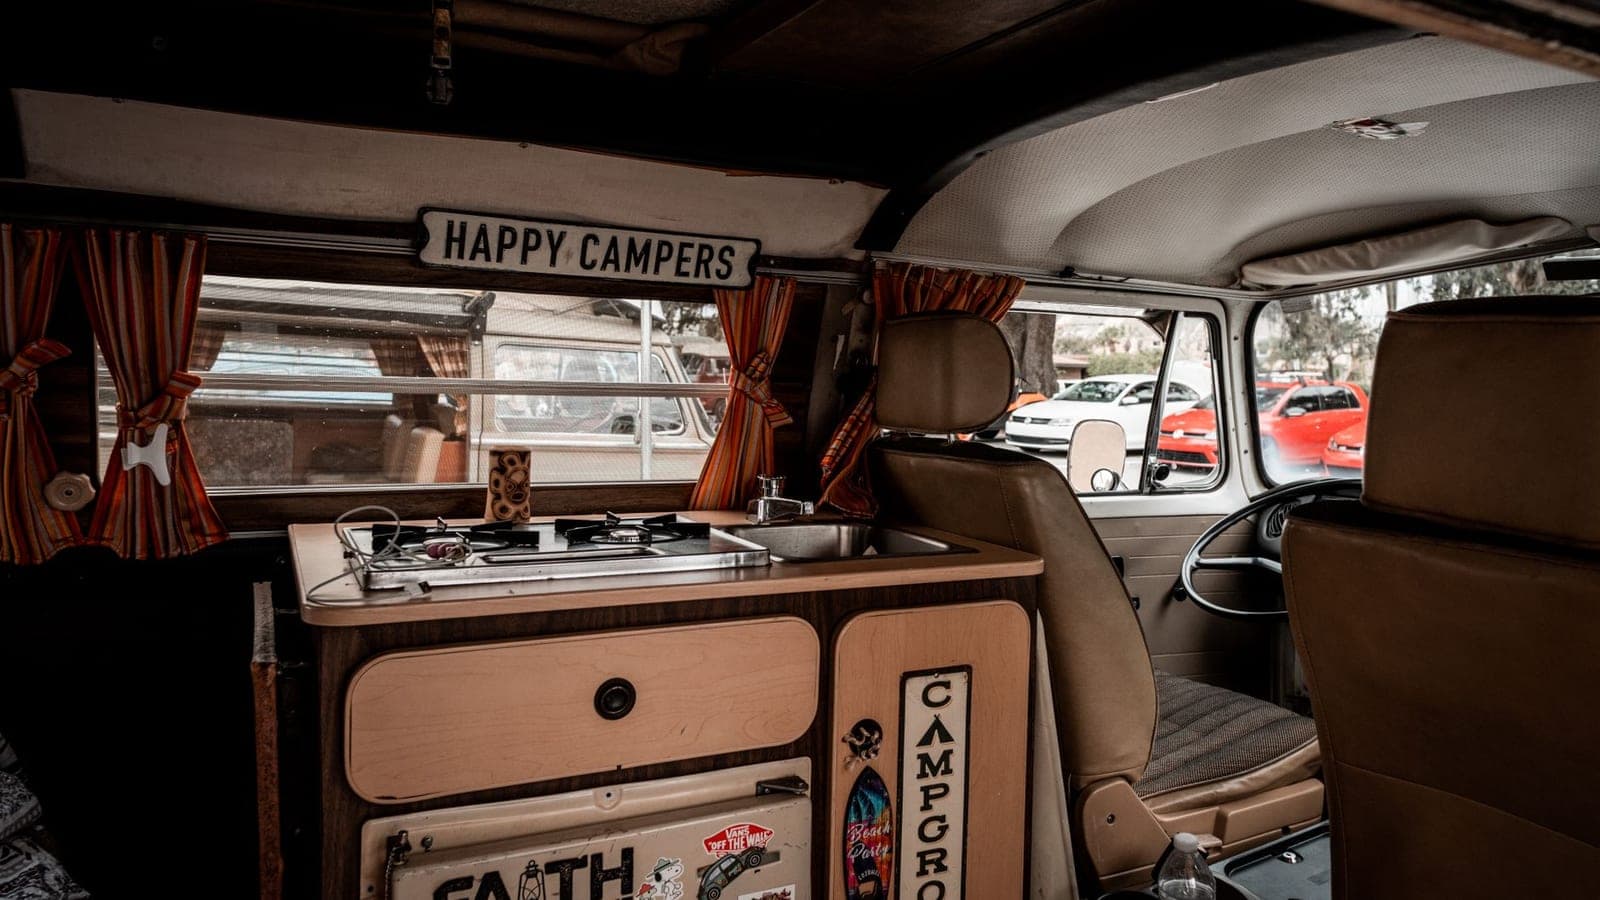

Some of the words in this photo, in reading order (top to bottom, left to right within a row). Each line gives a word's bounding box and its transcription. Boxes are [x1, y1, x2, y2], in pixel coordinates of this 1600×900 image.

[443, 219, 566, 267] HAPPY
[579, 232, 735, 280] CAMPERS
[915, 680, 954, 900] CAMPGRO
[726, 825, 749, 838] VANS
[848, 820, 890, 844] Beach
[728, 836, 745, 850] THE
[848, 842, 890, 863] Party
